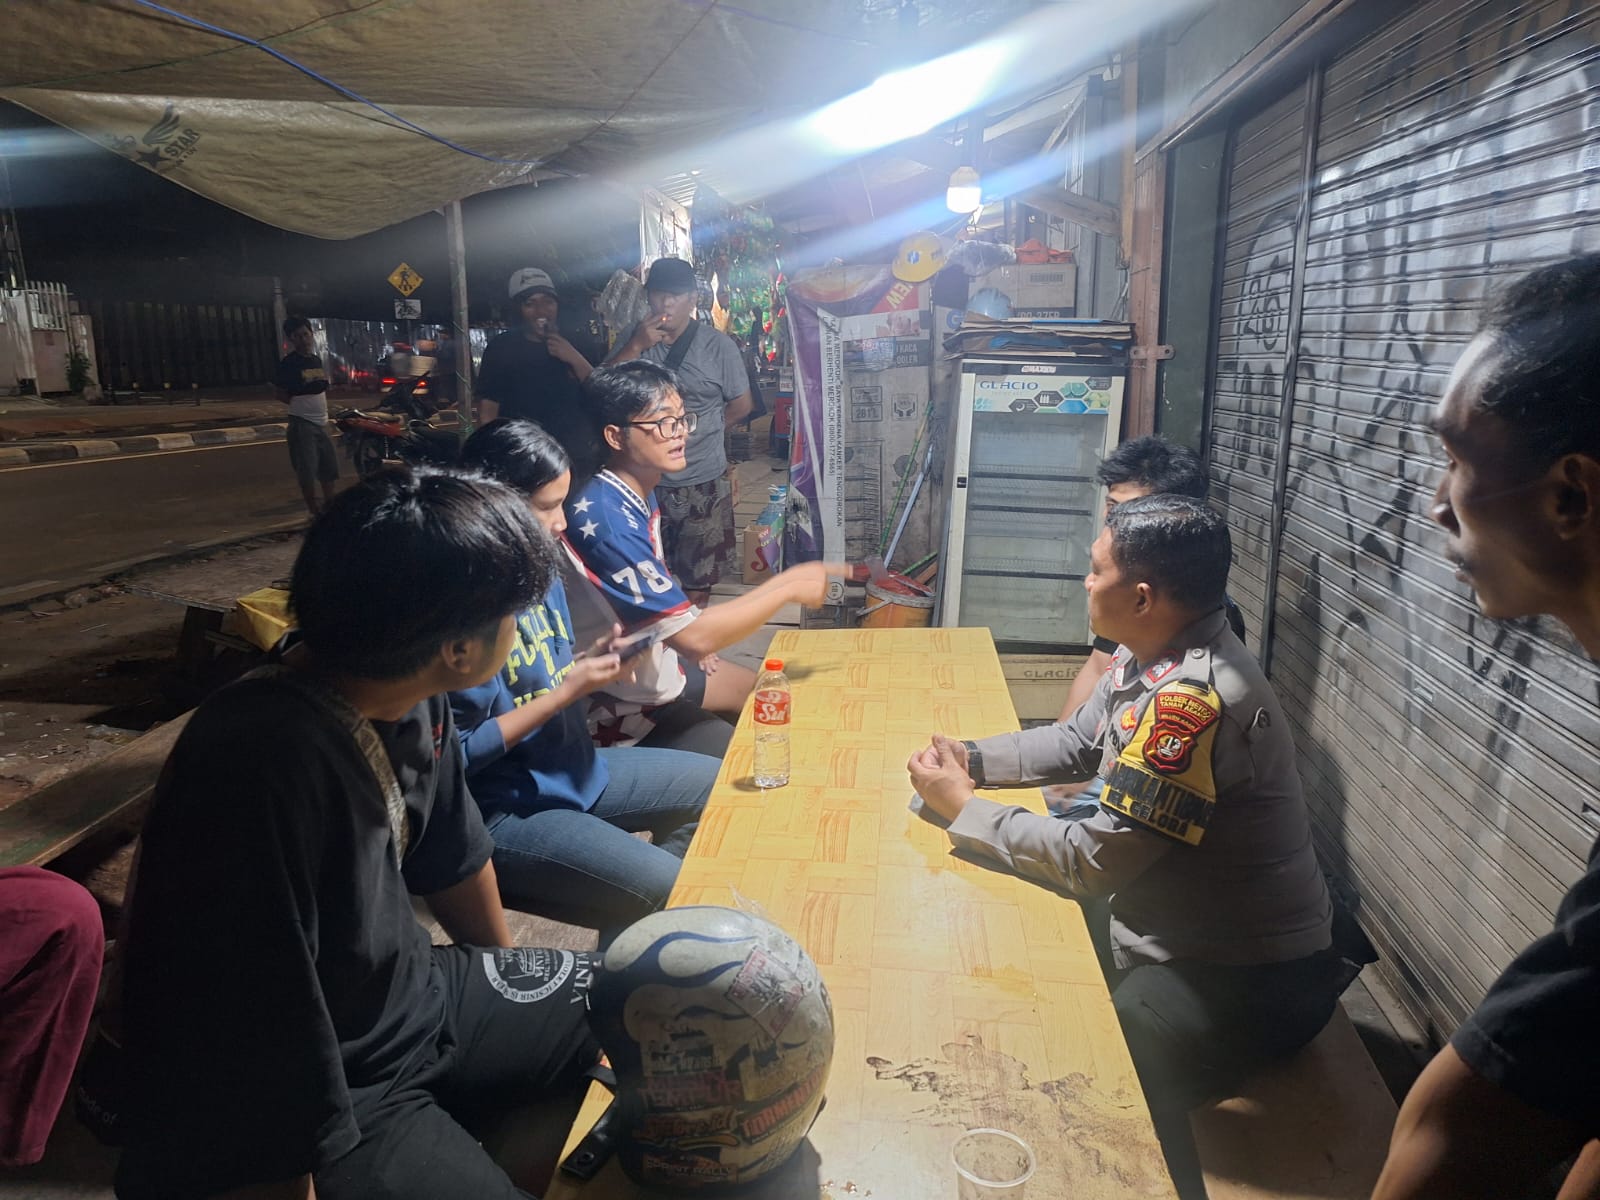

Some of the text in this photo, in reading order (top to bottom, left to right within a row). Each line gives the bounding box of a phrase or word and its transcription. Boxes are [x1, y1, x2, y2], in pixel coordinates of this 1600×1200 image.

[164, 129, 200, 157] STAR
[980, 381, 1039, 390] GLACIO
[612, 559, 673, 605] 78
[1160, 701, 1183, 709] TANAH
[1160, 695, 1212, 718] POLSEK METRO
